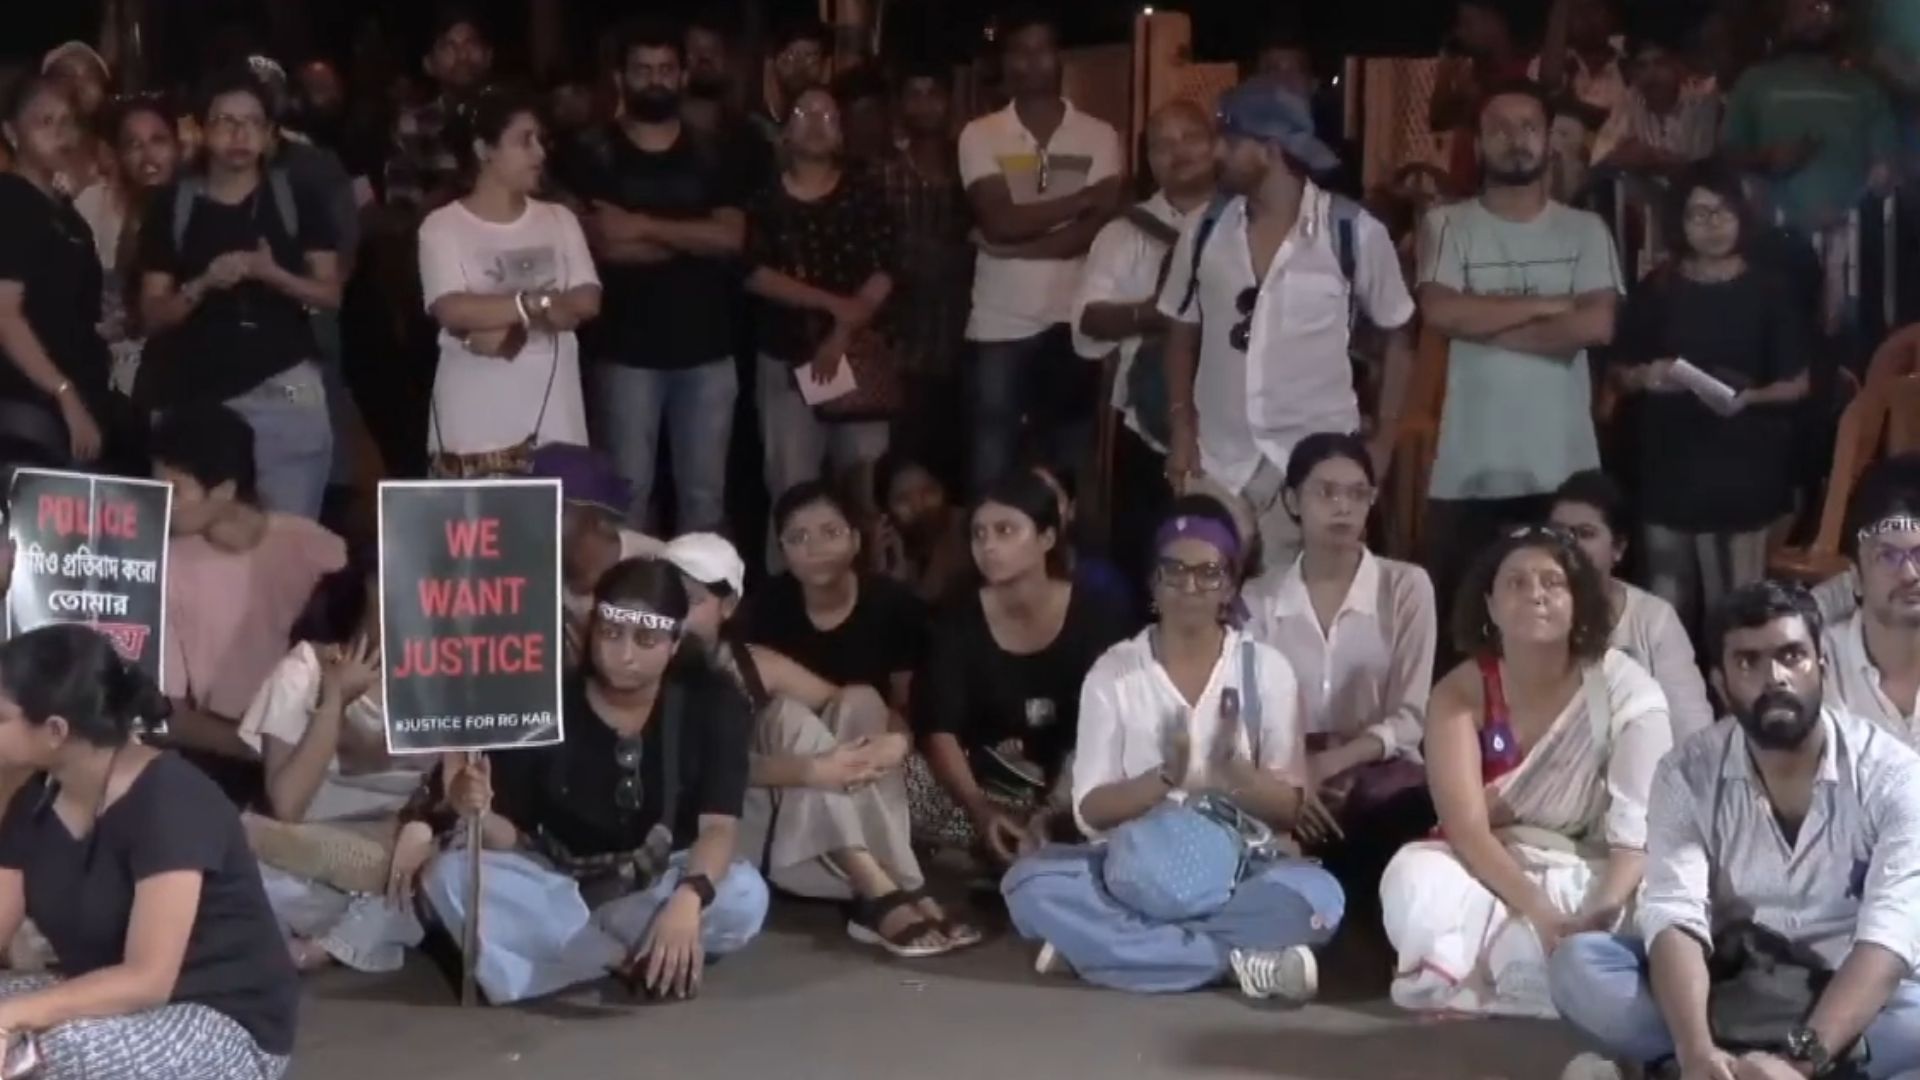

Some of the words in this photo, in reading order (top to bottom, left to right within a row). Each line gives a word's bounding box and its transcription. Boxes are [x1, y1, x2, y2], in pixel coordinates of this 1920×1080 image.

[38, 495, 138, 539] POLICE
[445, 518, 501, 559] WE
[61, 544, 119, 582] প্রতিবাদ
[121, 557, 157, 584] করো
[48, 588, 129, 616] তোমার
[417, 575, 527, 619] WANT
[394, 633, 545, 680] JUSTICE
[465, 715, 494, 729] FOR
[497, 713, 518, 727] RG
[521, 711, 552, 726] KAR
